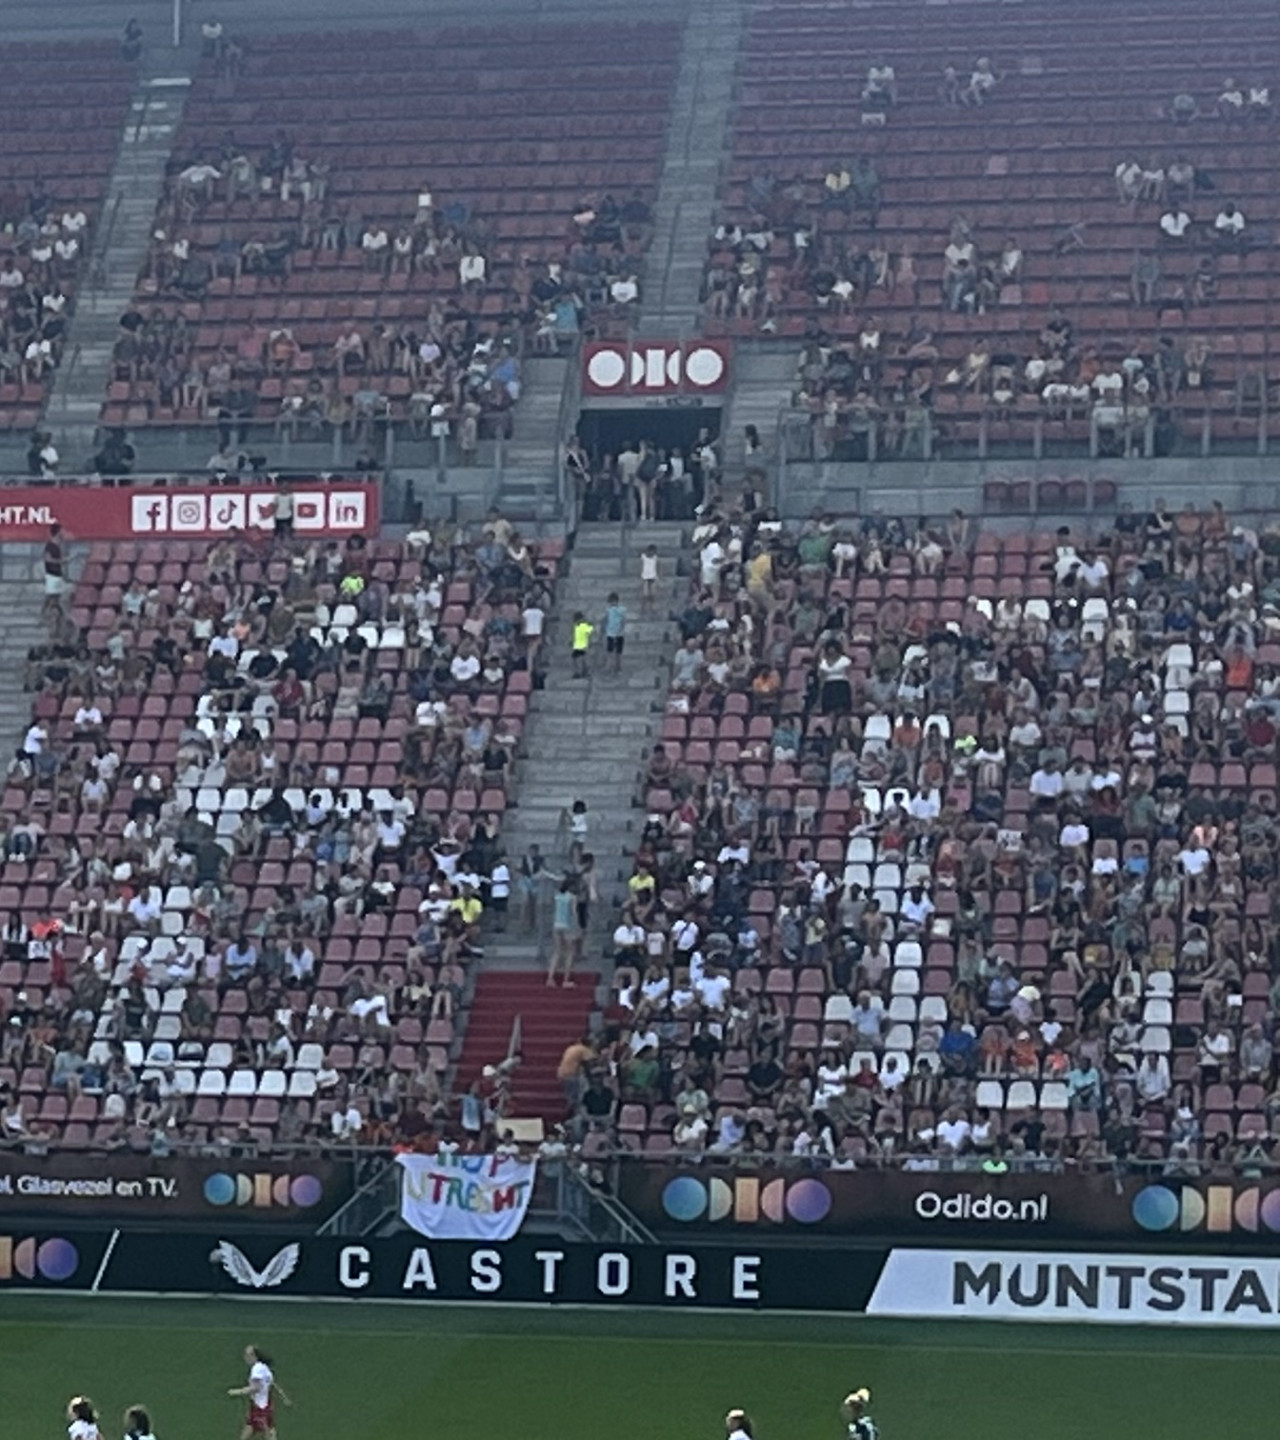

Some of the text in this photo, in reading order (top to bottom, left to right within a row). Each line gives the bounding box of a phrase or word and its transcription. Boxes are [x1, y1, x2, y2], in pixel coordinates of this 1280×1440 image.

[17, 1174, 112, 1197] Glasvezel
[116, 1180, 142, 1196] en
[915, 1191, 1048, 1222] Odido.nl
[339, 1245, 761, 1299] CASTORE
[953, 1261, 1280, 1314] MUNTSTA
